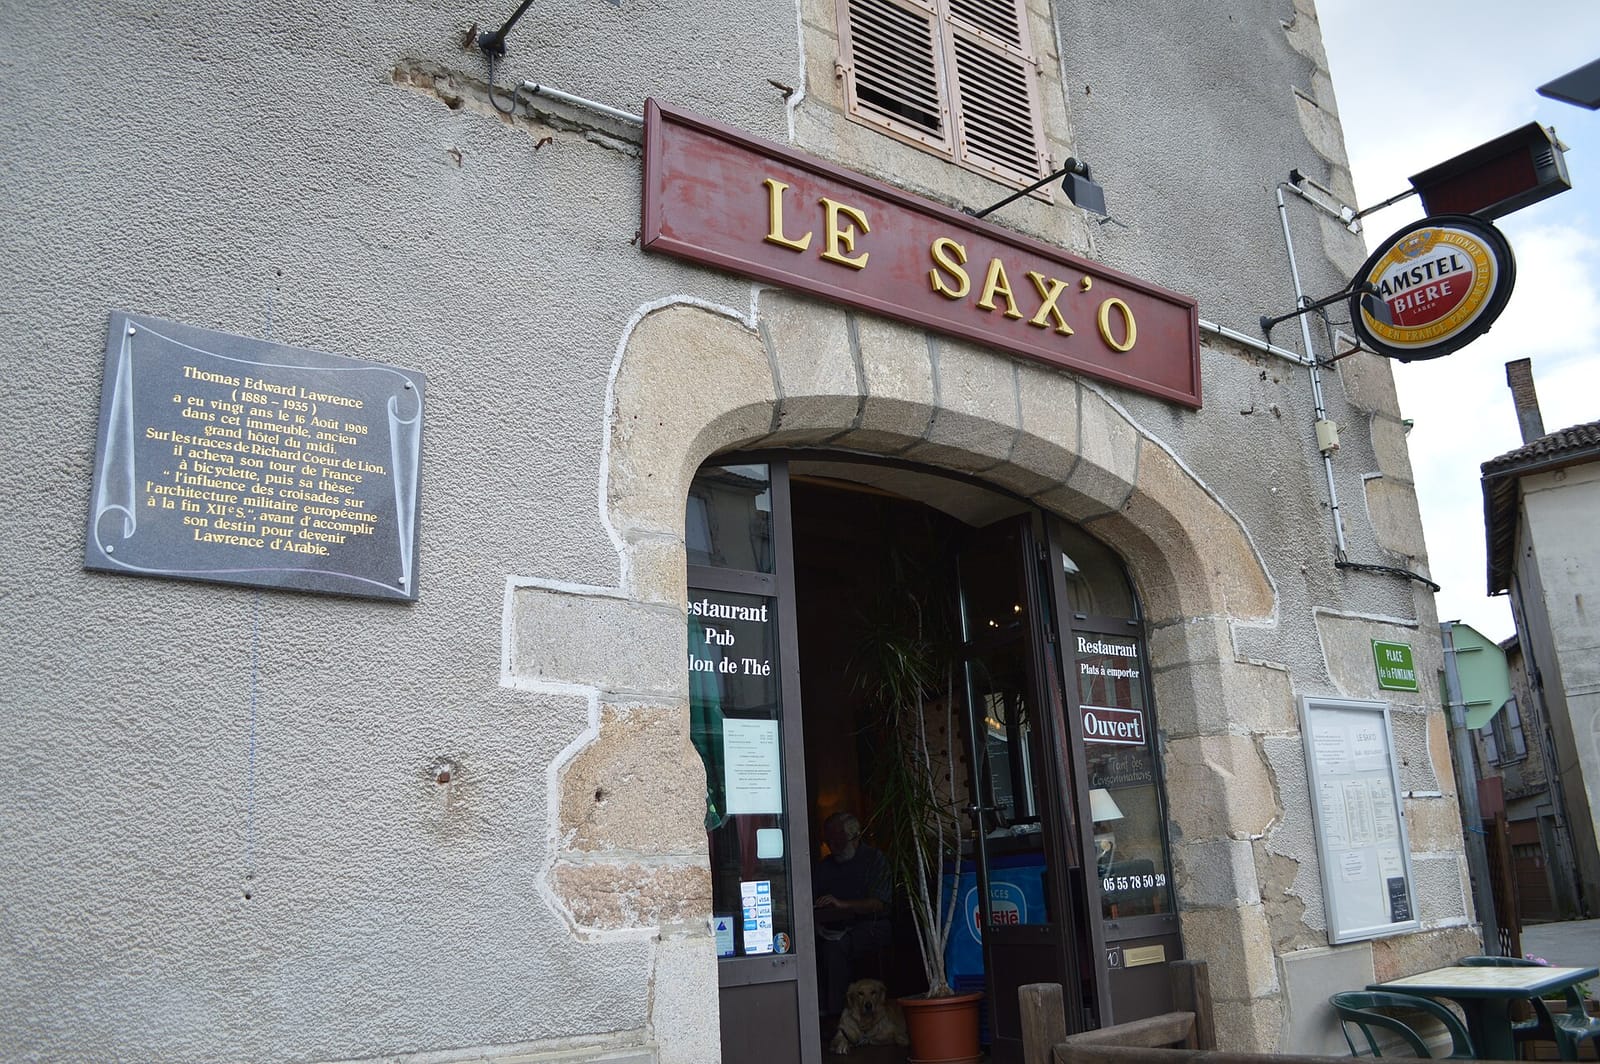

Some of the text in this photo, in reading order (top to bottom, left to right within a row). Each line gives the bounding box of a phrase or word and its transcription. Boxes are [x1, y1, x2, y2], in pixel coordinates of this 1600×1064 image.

[763, 178, 1138, 352] LE SAX'O
[1381, 254, 1464, 296] AMSTEL
[1394, 281, 1453, 314] BIERE
[1413, 302, 1436, 314] LAGER
[183, 366, 364, 409] Thomas Edward Lawrence
[173, 394, 368, 435] a eu vingt ans le 16 Août 1908
[182, 407, 357, 445] dans cet immeuble, ancien
[146, 427, 170, 440] Sur
[171, 431, 191, 444] les
[192, 435, 233, 451] traces
[233, 441, 250, 453] de
[251, 444, 301, 461] Richard
[302, 452, 340, 467] Coeur
[342, 458, 357, 470] de
[204, 425, 337, 455] grand hôtel du midi.
[173, 445, 363, 483] il acheva son tour de France
[179, 458, 188, 470] à
[265, 474, 294, 486] puis
[299, 479, 313, 489] sa
[318, 480, 355, 495] thèse:
[243, 496, 299, 512] militaire
[303, 505, 378, 523] européenne
[251, 483, 274, 496] des
[279, 489, 340, 505] croisades
[344, 498, 365, 508] sur
[147, 495, 156, 507] à
[162, 496, 175, 509] la
[181, 499, 200, 512] fin
[260, 511, 294, 525] avant
[183, 515, 346, 544] son destin pour devenir
[194, 529, 265, 548] Lawrence
[688, 599, 768, 622] estaurant
[705, 628, 735, 646] Pub
[1077, 636, 1137, 657] Restaurant
[689, 654, 770, 676] lon de Thé
[1081, 663, 1099, 675] Plats
[1107, 668, 1140, 679] emporter
[1084, 712, 1141, 738] Ouvert
[1104, 873, 1165, 891] 05 55 78 50 29
[1108, 951, 1119, 967] 10
